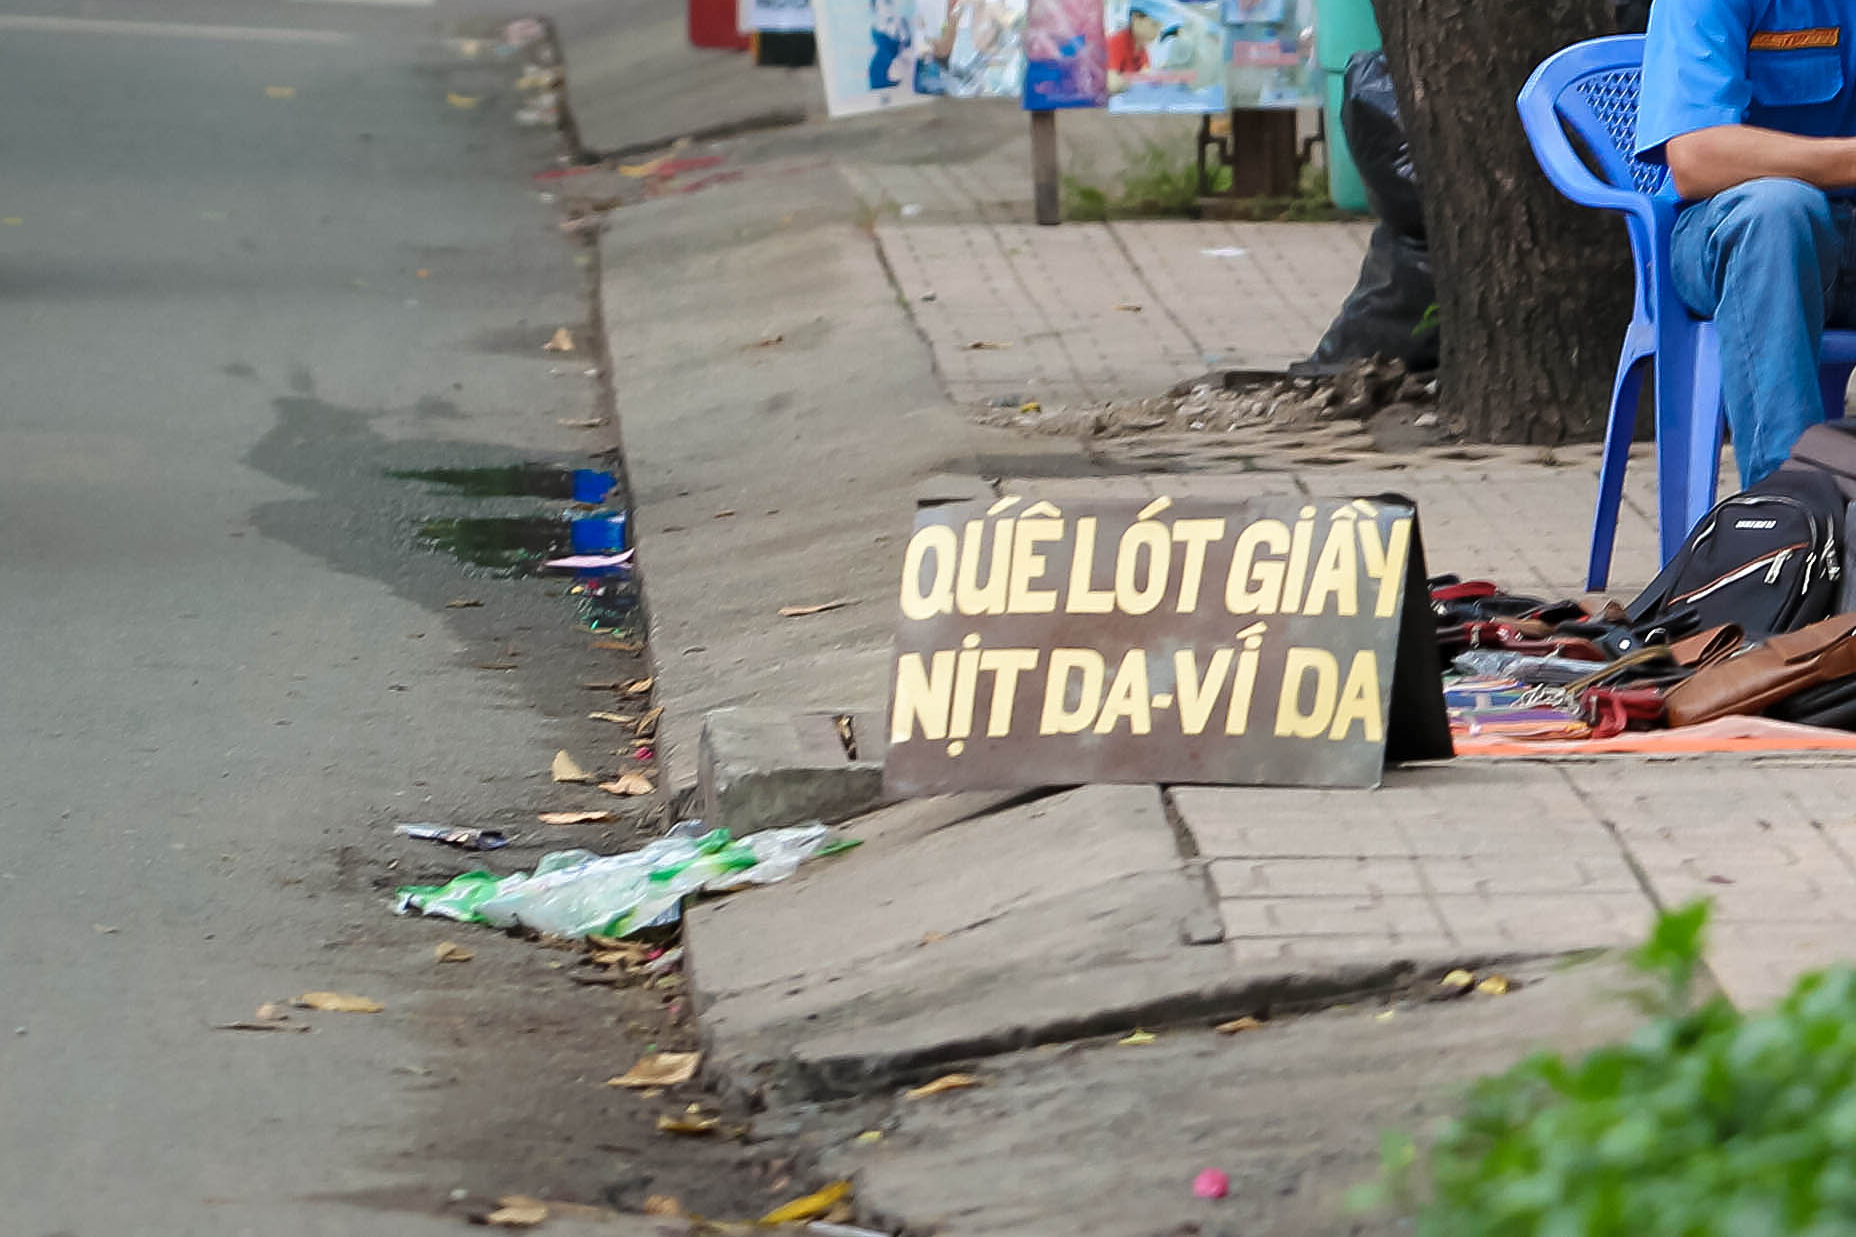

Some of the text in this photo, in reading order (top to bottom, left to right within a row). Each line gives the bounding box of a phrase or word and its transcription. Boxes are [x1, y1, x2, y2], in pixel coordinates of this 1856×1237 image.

[1066, 496, 1225, 615] LÓT
[891, 632, 1040, 757] NỊT
[1274, 648, 1384, 742] DA
